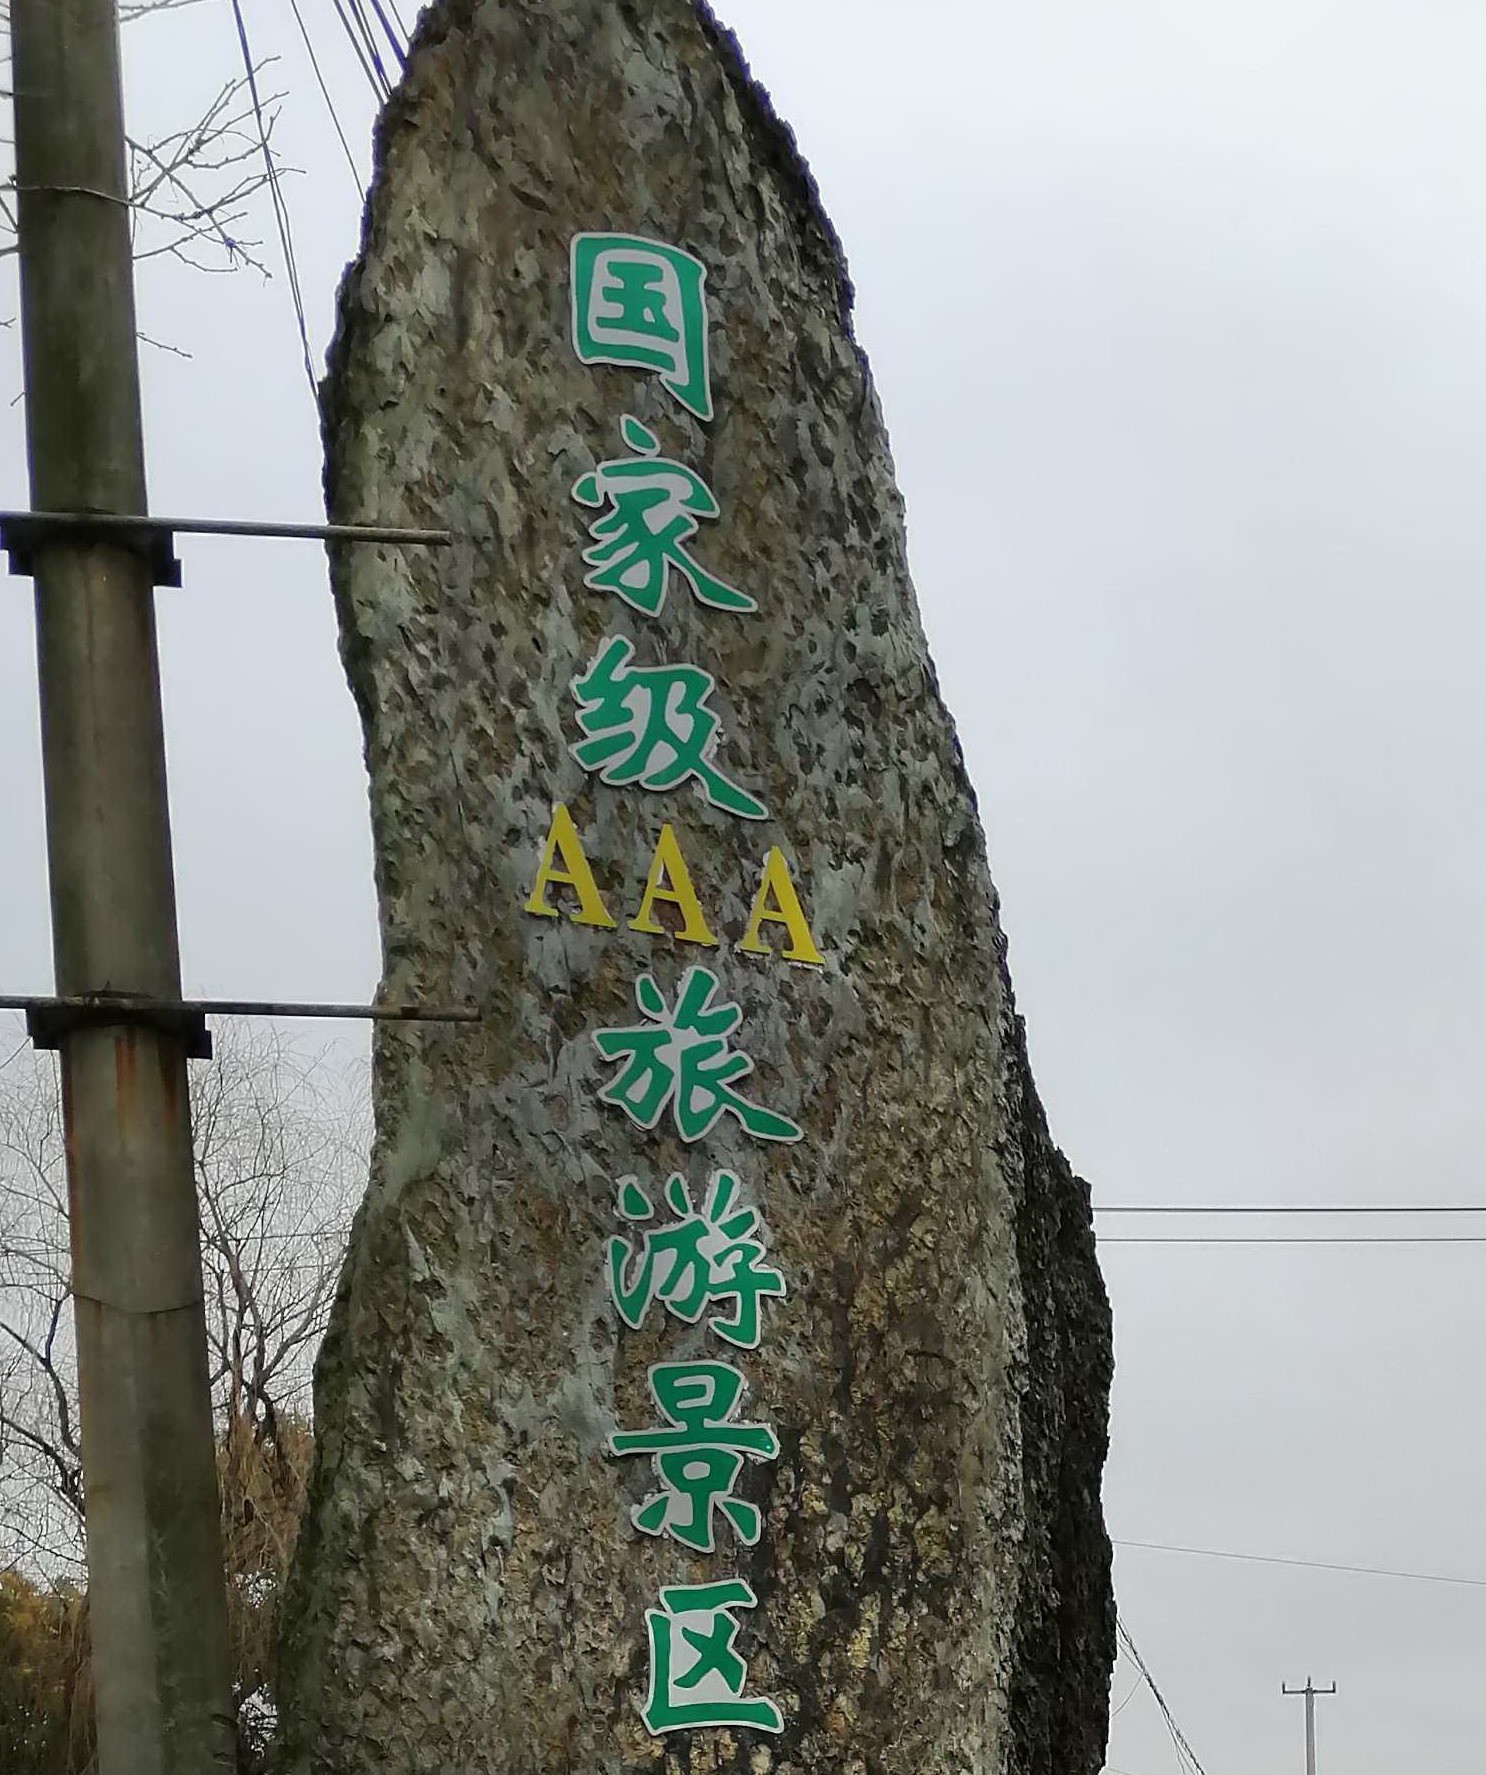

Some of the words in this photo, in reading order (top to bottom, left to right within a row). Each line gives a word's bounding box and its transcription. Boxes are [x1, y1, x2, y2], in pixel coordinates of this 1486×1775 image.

[570, 231, 769, 820] 国家级
[524, 803, 826, 965] AAA
[592, 965, 803, 1735] 旅游景区
